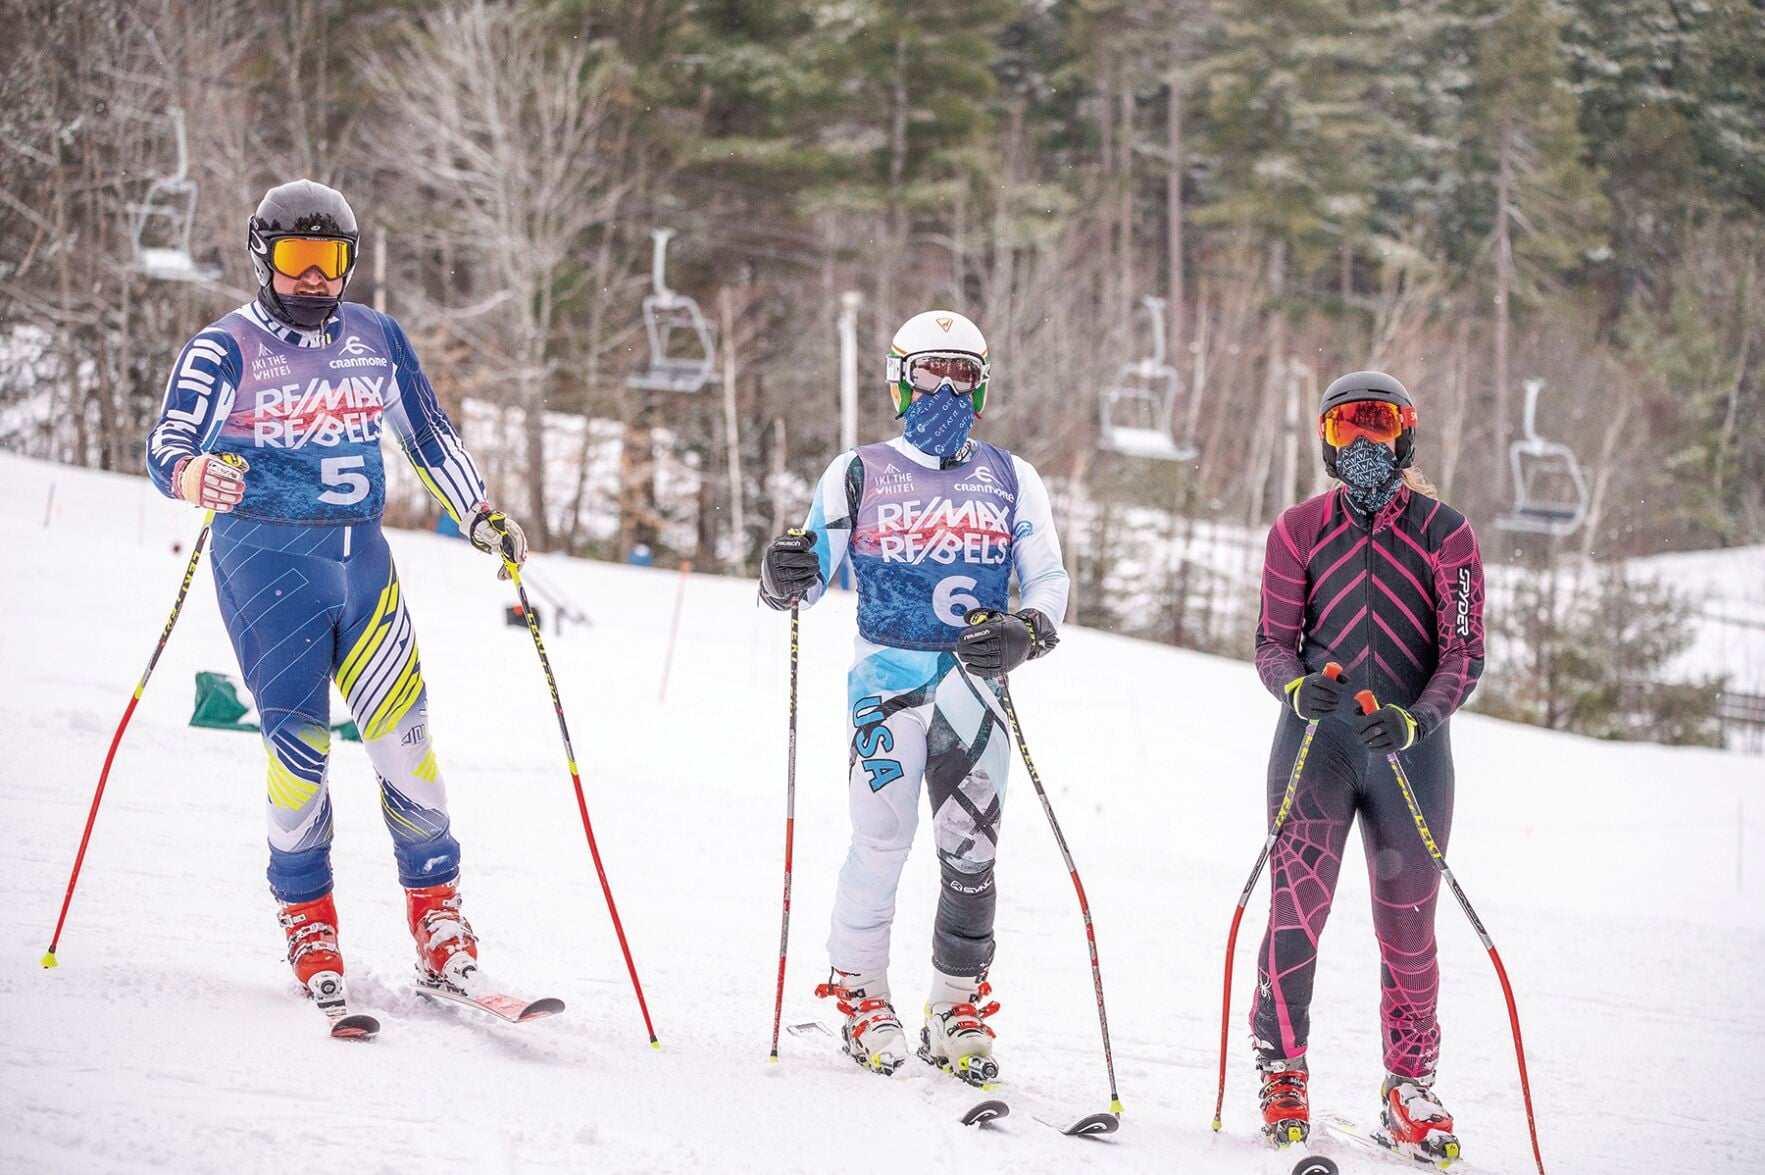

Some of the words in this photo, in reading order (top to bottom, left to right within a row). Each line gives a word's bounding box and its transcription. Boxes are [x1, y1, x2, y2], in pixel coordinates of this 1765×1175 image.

[252, 359, 266, 371] SKI
[268, 354, 288, 366] THE
[253, 365, 291, 380] WHITES
[254, 377, 384, 418] RE/MAX
[316, 455, 370, 505] 5
[875, 475, 890, 486] SKI
[893, 472, 912, 482] THE
[875, 483, 914, 495] WHITES
[878, 496, 1010, 534] RE/MAX
[880, 529, 1007, 565] RE/BELS
[932, 575, 981, 628] 6
[1457, 568, 1470, 636] SPYDER
[852, 696, 904, 793] USA
